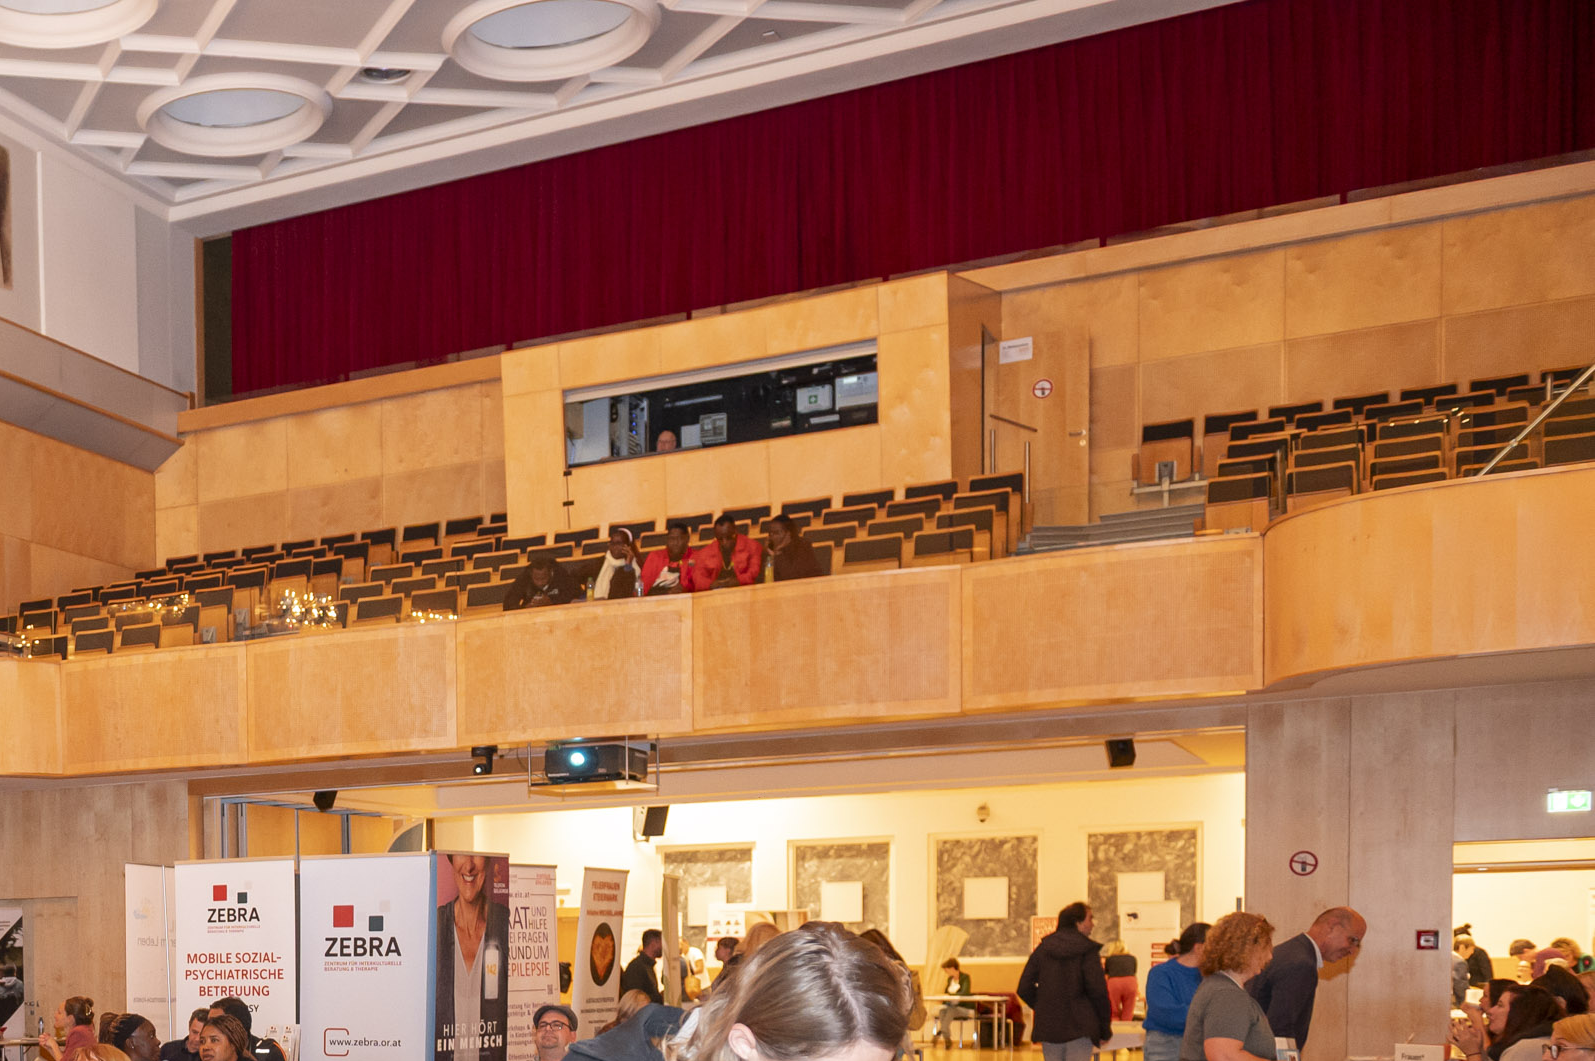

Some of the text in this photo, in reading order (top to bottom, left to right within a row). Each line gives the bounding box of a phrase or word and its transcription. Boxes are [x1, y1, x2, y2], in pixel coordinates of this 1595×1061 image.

[207, 907, 260, 923] ZEBRA
[532, 906, 547, 916] UND
[529, 918, 548, 929] HILFE
[518, 931, 549, 943] FRAGEN
[325, 937, 401, 957] ZEBRA
[534, 945, 550, 959] UM
[187, 952, 281, 964] MOBILE SOZIAL-
[185, 969, 284, 980] PSYCHIATRISCHE
[199, 986, 270, 997] BETREUUNG
[444, 1019, 497, 1037] HIER HÖRT
[329, 1037, 401, 1047] www.zebra.or.at
[437, 1035, 503, 1052] EIN MENSCH
